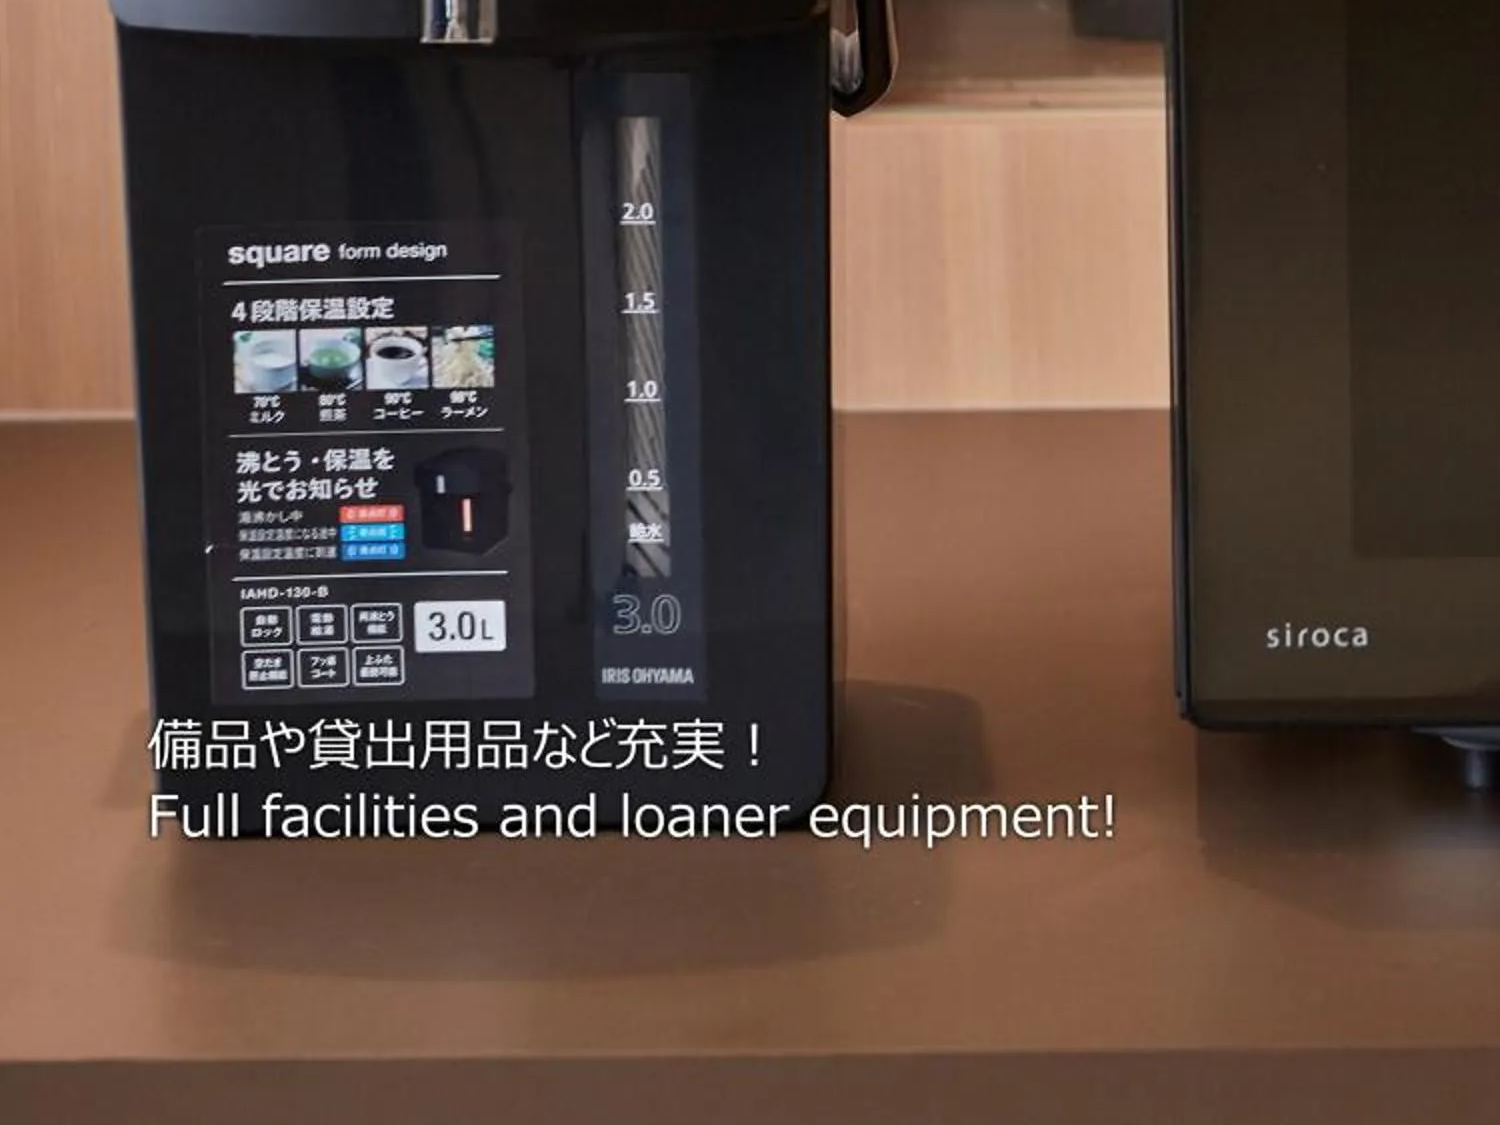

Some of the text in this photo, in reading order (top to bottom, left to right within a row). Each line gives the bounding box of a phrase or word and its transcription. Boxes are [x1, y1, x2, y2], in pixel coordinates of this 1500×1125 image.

[622, 201, 653, 220] 2.0
[228, 242, 448, 267] square form design
[625, 292, 655, 309] 1.5
[628, 380, 657, 397] 1.0
[236, 448, 395, 474] 沸とう・保温を
[628, 469, 661, 487] 0.5
[237, 477, 379, 503] 光でお知らせ
[613, 594, 682, 634] 3.0
[1266, 622, 1368, 648] siroca
[602, 667, 694, 684] IRIS OHYAMA
